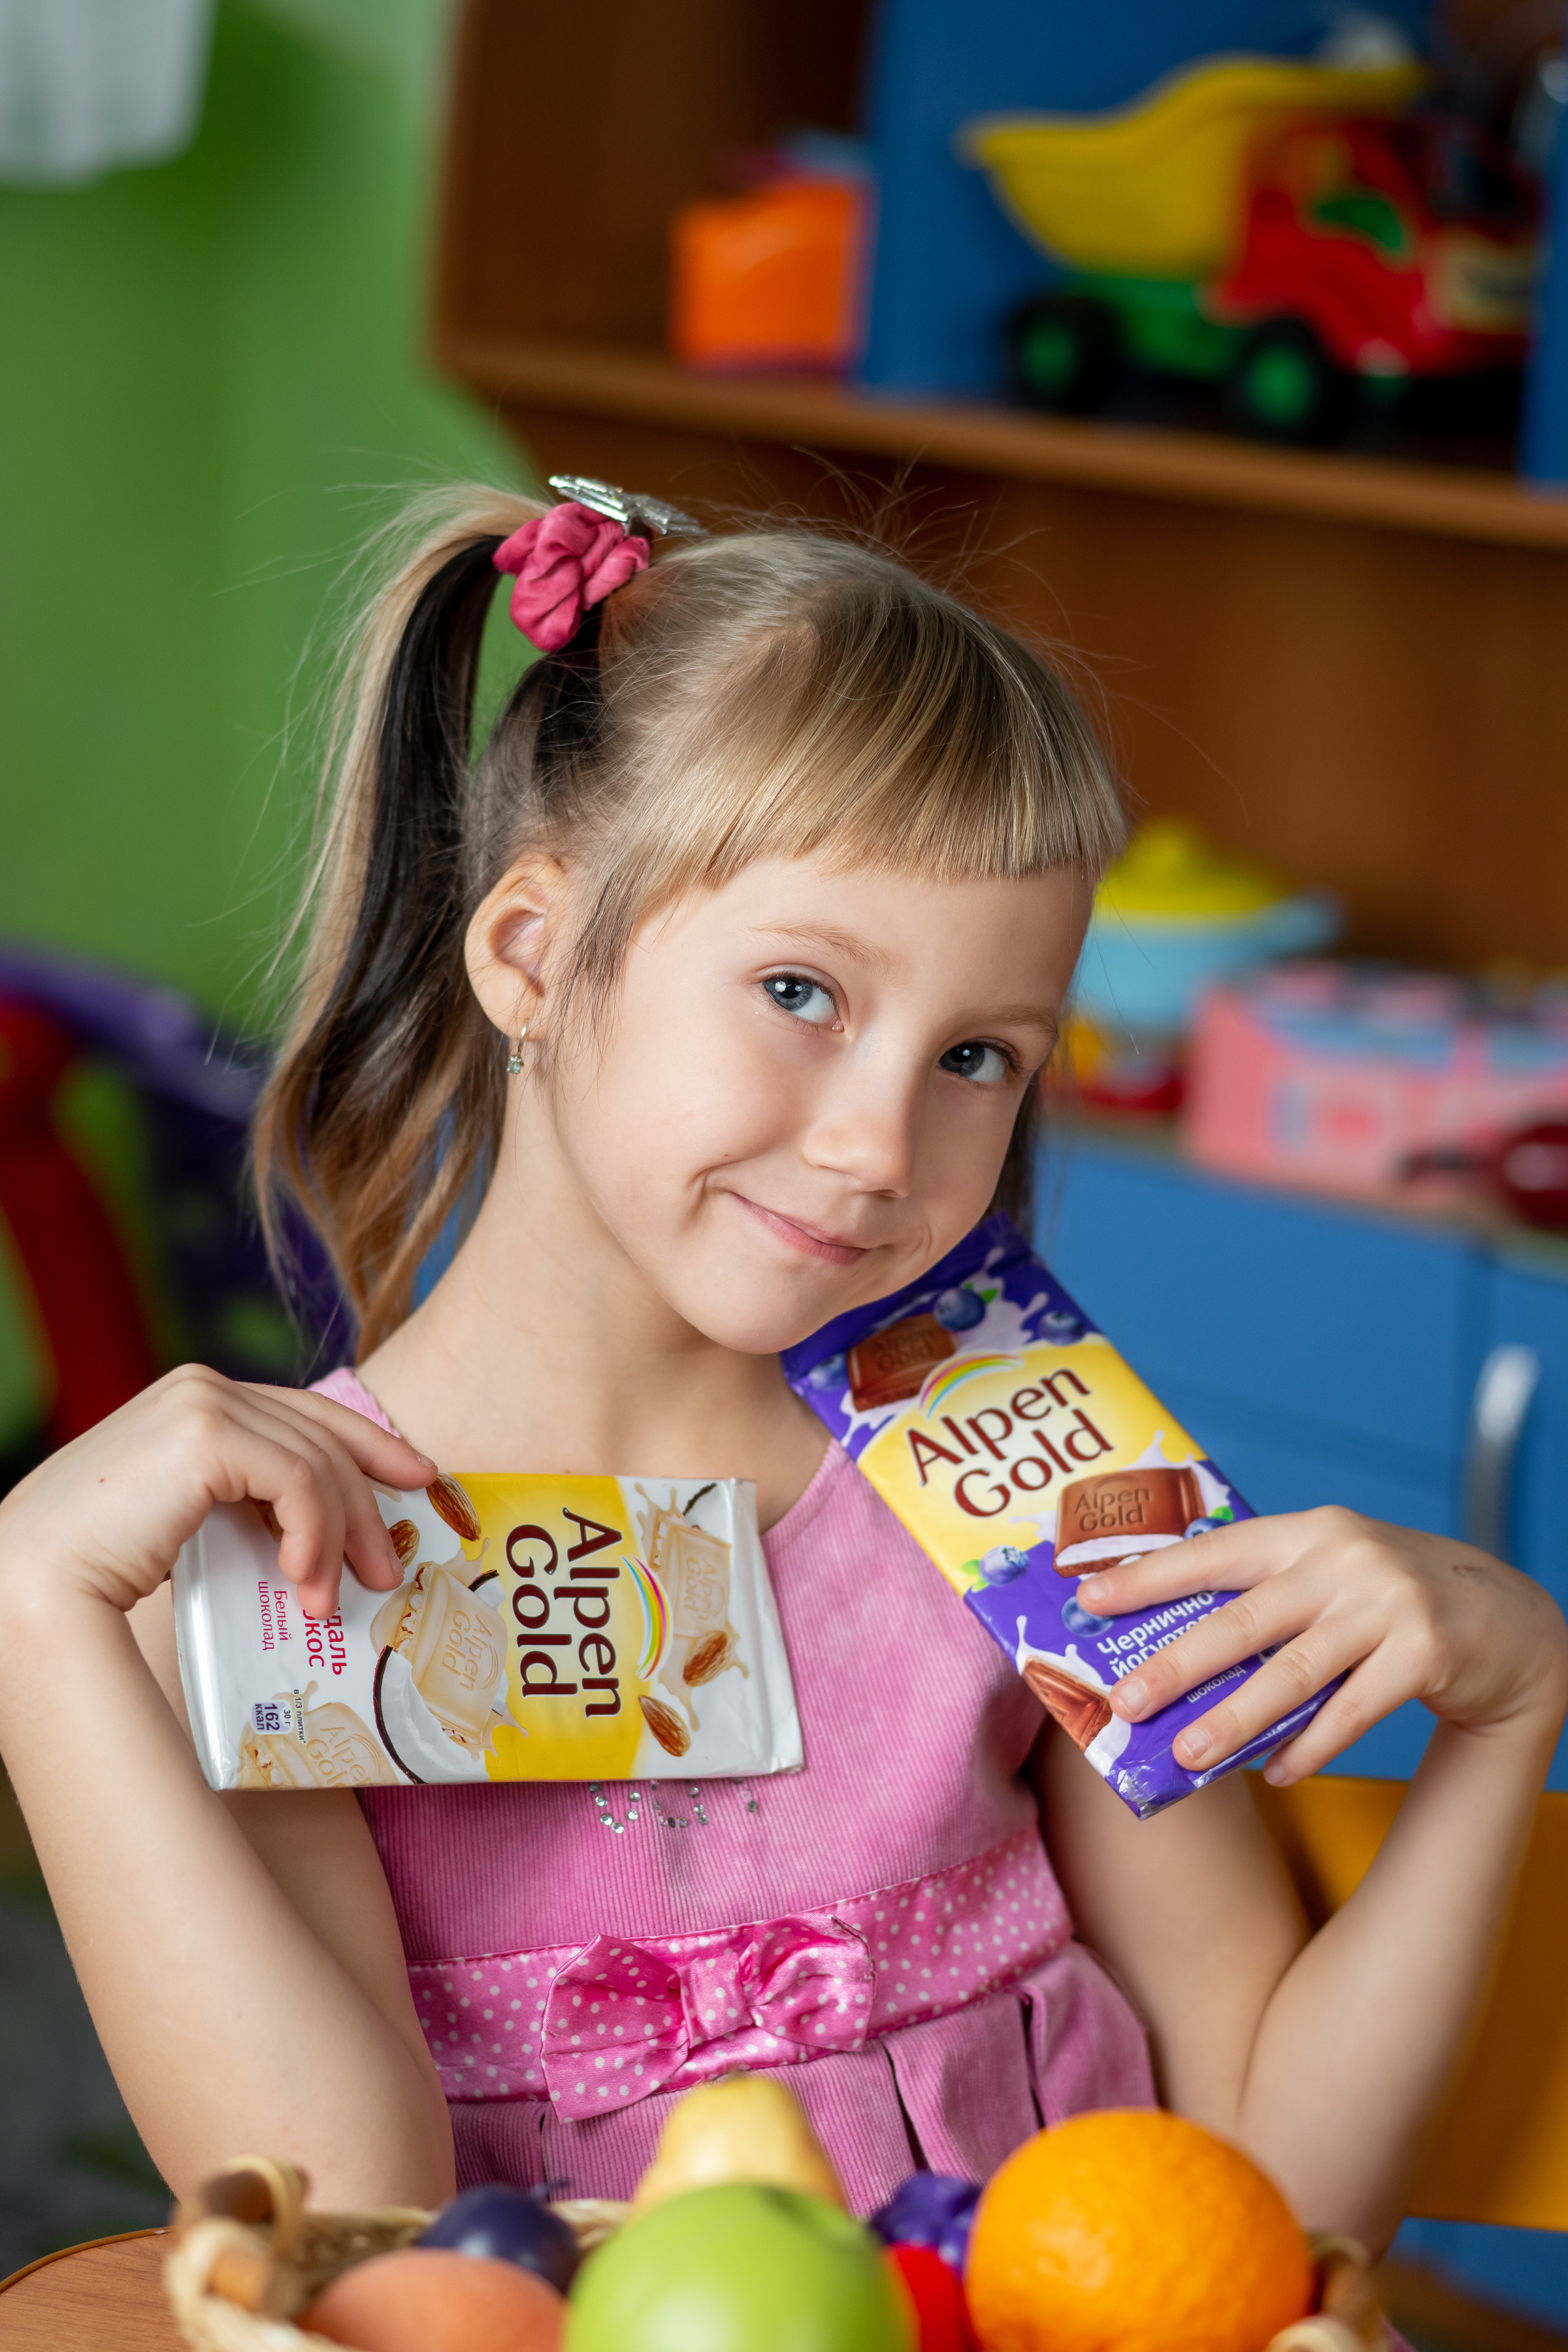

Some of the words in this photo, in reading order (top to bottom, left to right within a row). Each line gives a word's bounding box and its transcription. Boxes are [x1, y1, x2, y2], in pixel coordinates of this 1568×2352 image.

[906, 1367, 1092, 1486] Alpen
[955, 1408, 1115, 1517] Gold
[1075, 1488, 1149, 1514] Alpen
[1079, 1503, 1143, 1531] Gold
[506, 1524, 578, 1697] Gold
[553, 1507, 623, 1718] Alpen
[683, 1556, 701, 1612] Gold
[258, 1582, 275, 1650] шоколад
[274, 1591, 292, 1641] Белый
[323, 1607, 348, 1675] даль
[441, 1610, 471, 1676] Gold
[459, 1615, 492, 1691] Alpen
[284, 1710, 291, 1719] 30
[1186, 1665, 1247, 1703] шоколад
[255, 1704, 265, 1730] ккал
[264, 1703, 280, 1731] 162
